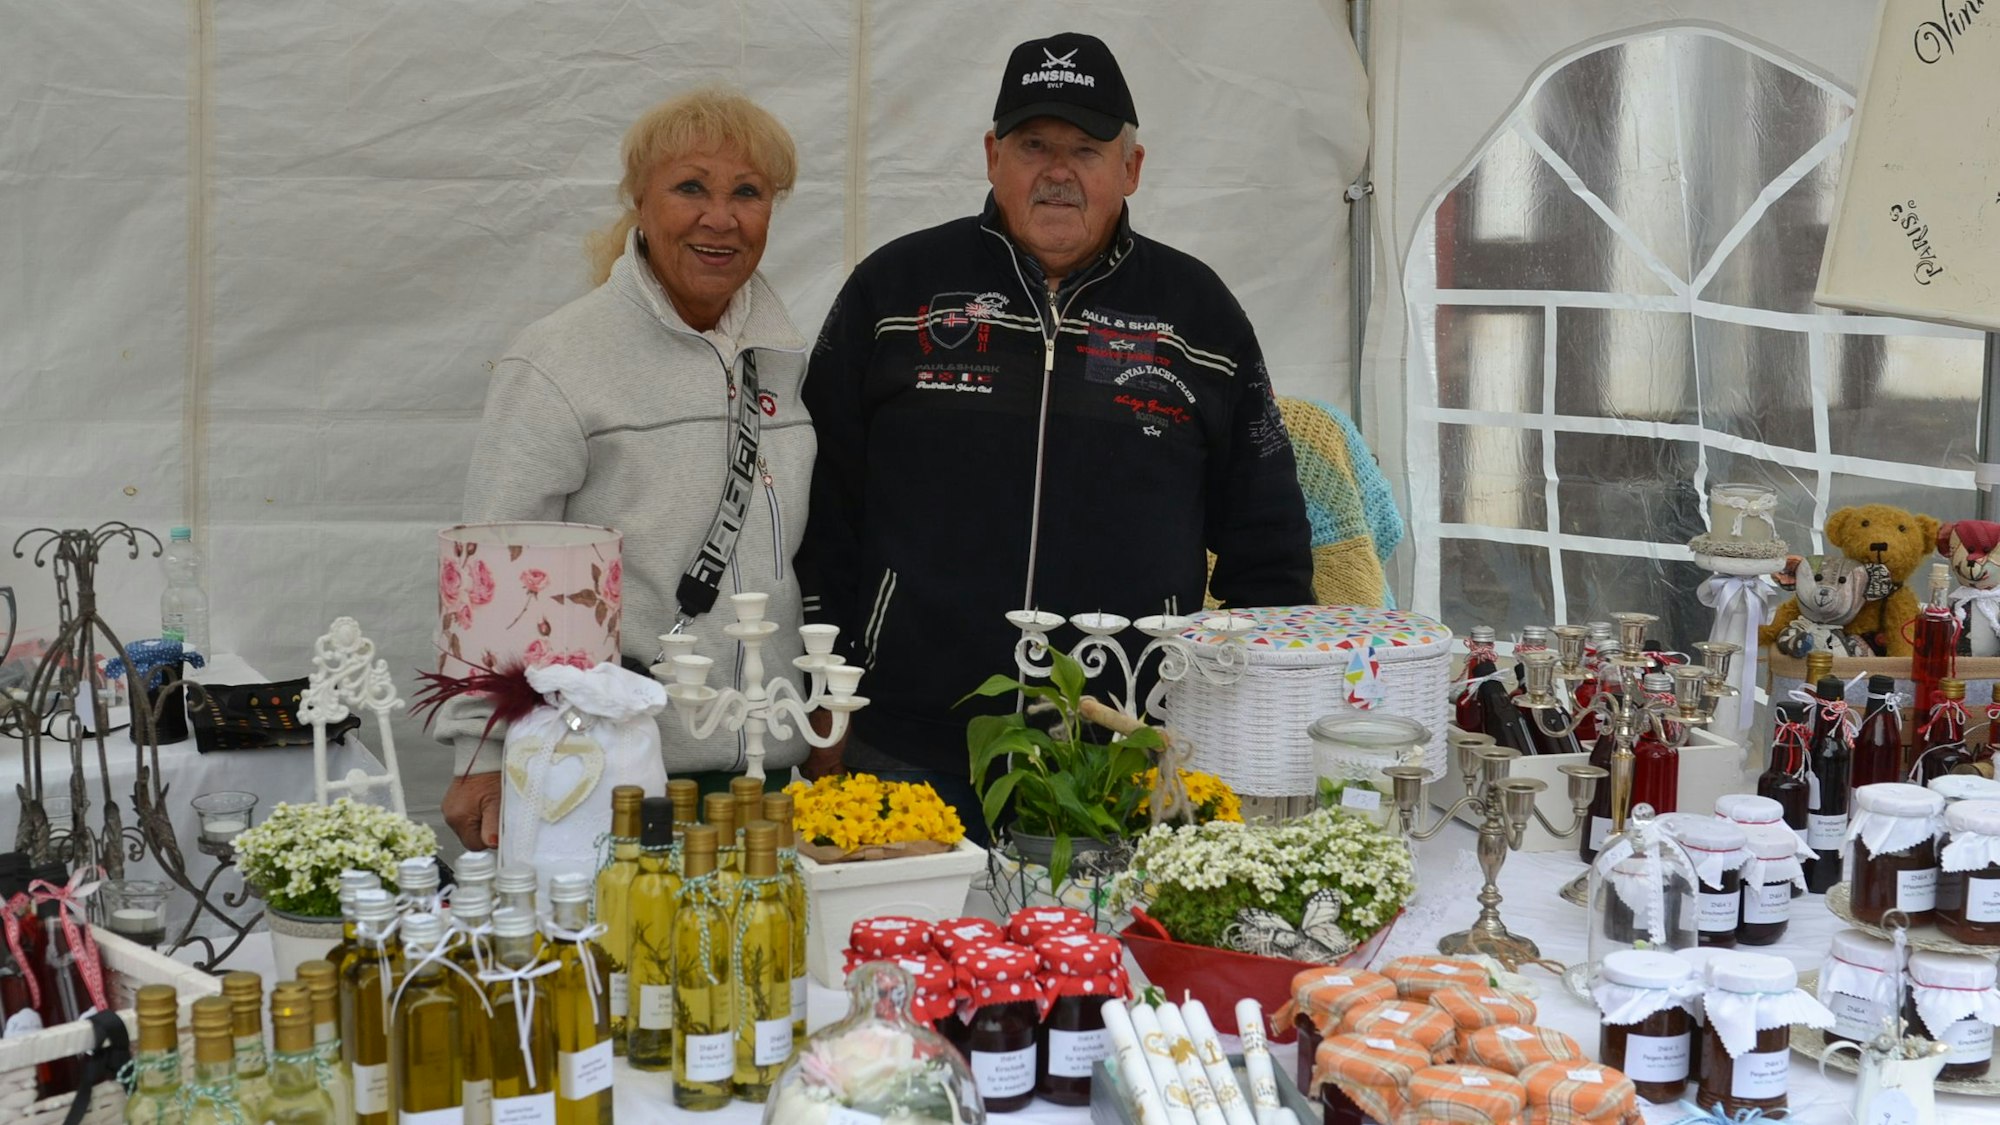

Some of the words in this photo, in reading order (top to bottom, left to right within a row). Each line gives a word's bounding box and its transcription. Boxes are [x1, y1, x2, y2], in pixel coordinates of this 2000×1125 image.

[1021, 70, 1095, 88] SANSIBAR
[1081, 309, 1112, 326] PAUL
[1114, 319, 1126, 329] &
[1128, 321, 1174, 333] SHARK
[1114, 366, 1146, 386] ROYAL
[1145, 365, 1178, 383] YACHT
[1175, 380, 1196, 404] CLUB
